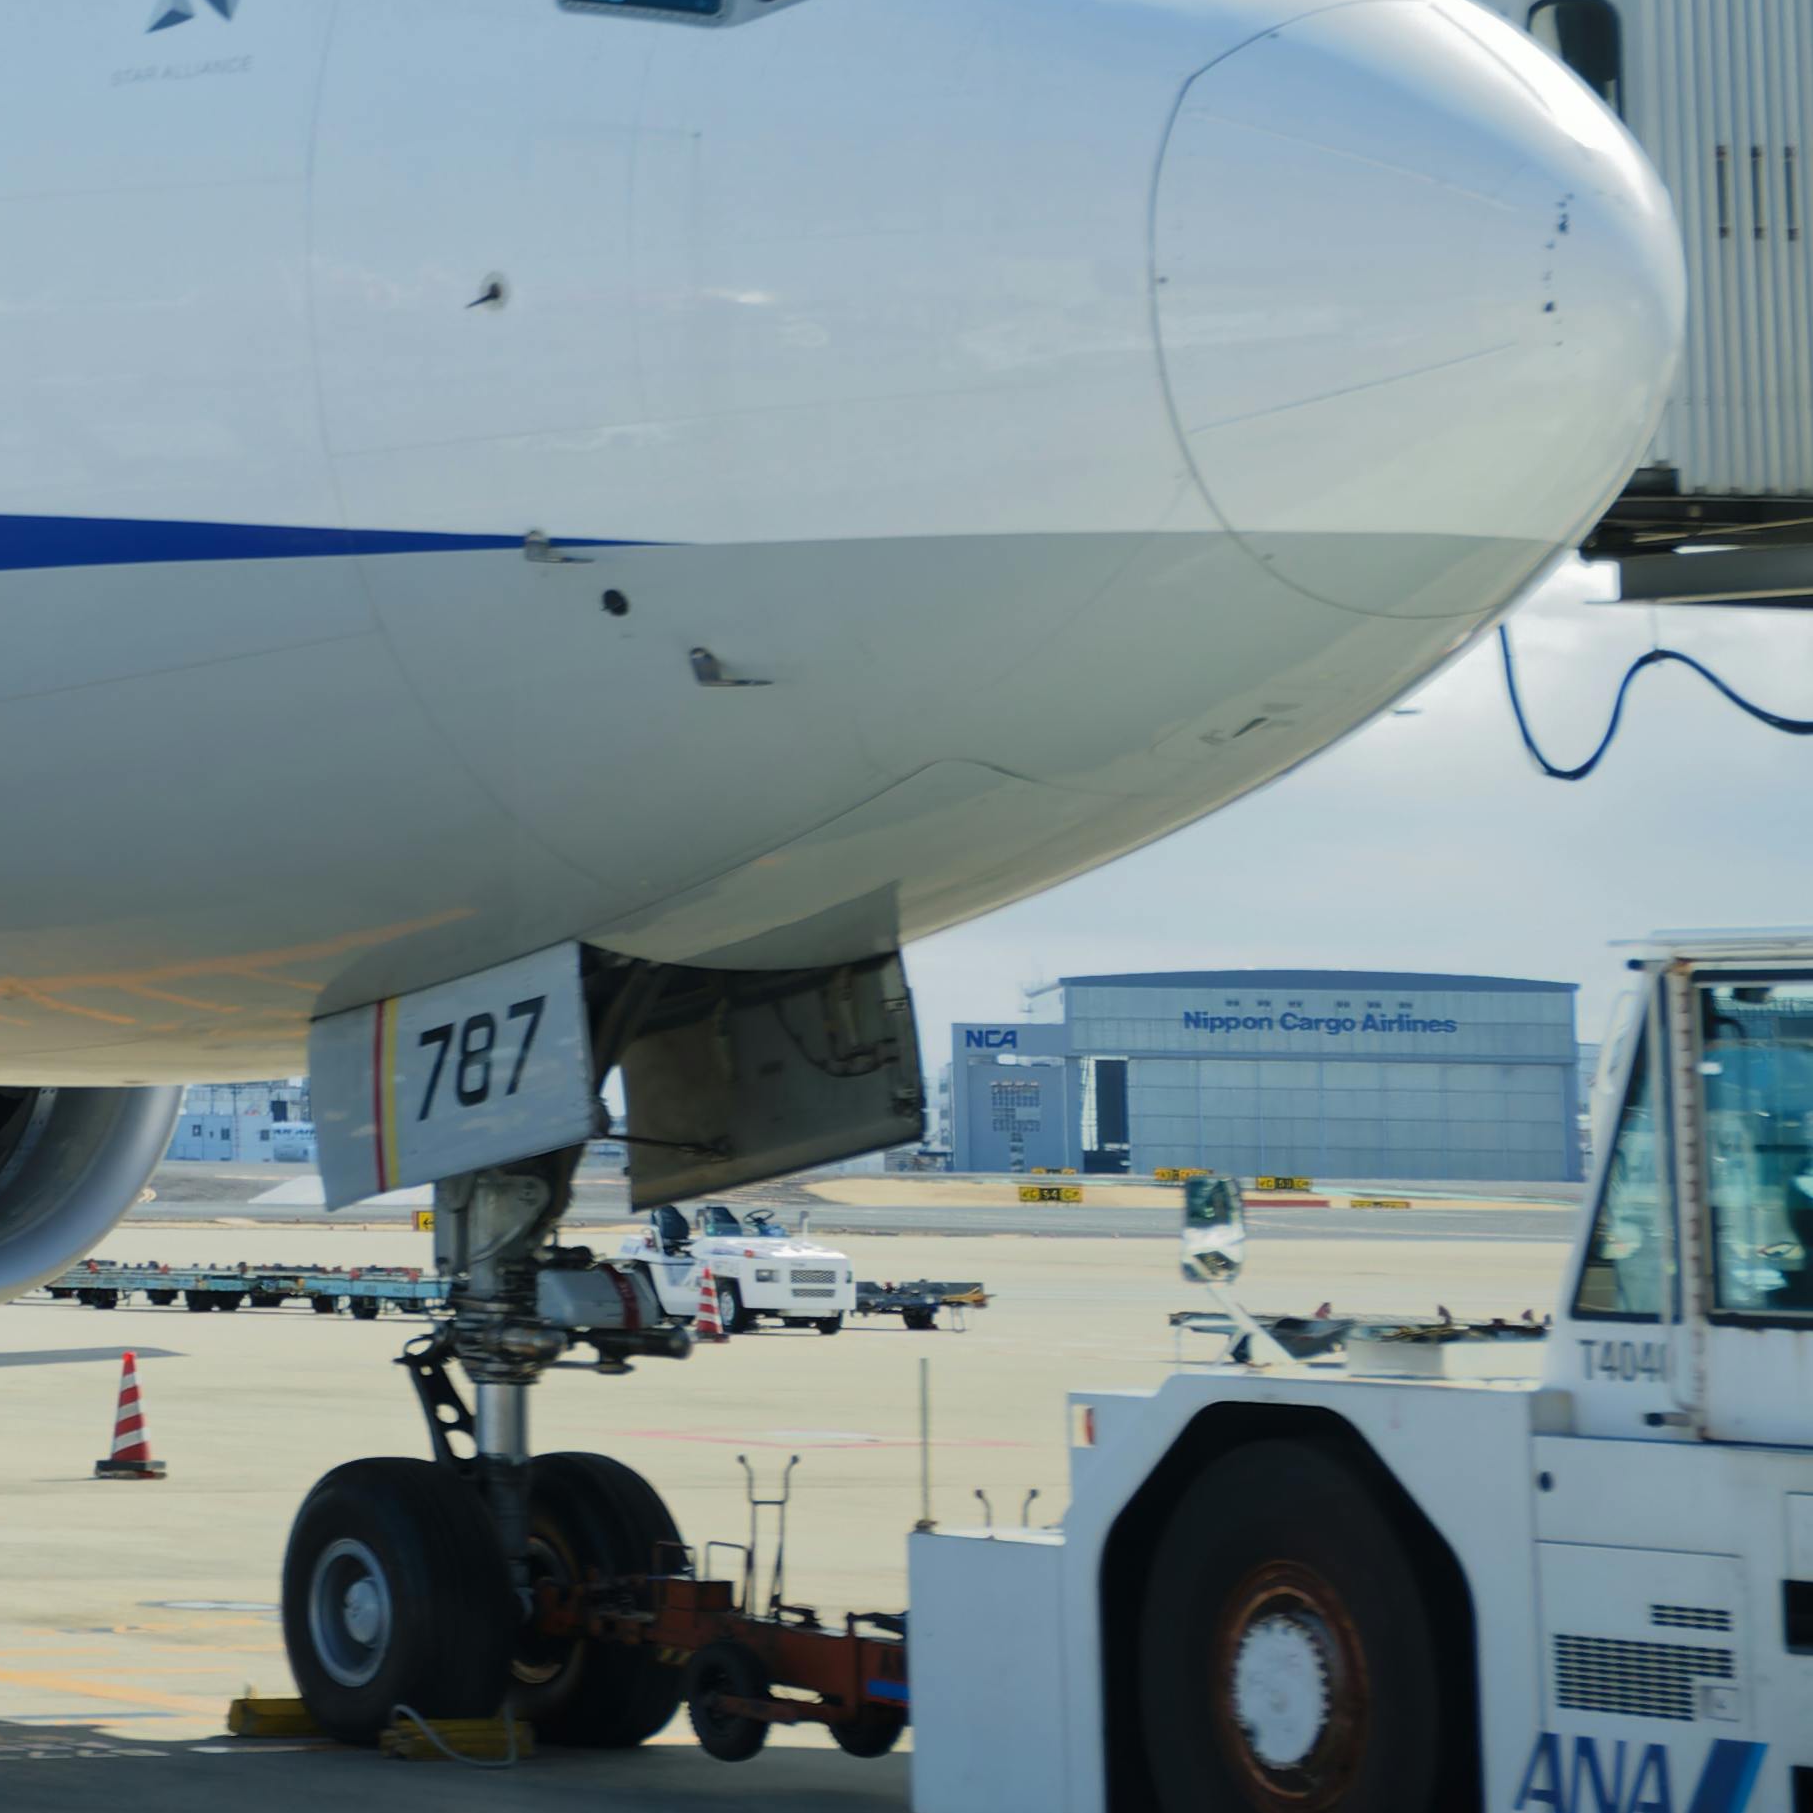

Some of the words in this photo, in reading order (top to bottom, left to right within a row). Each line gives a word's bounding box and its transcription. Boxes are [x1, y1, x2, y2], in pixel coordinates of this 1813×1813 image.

[965, 1029, 1018, 1049] NCA
[1183, 1011, 1273, 1033] Nippon
[1279, 1013, 1356, 1035] Cargo
[1361, 1013, 1459, 1034] Airlines
[416, 995, 547, 1122] 787
[1512, 1731, 1673, 1813] ANA
